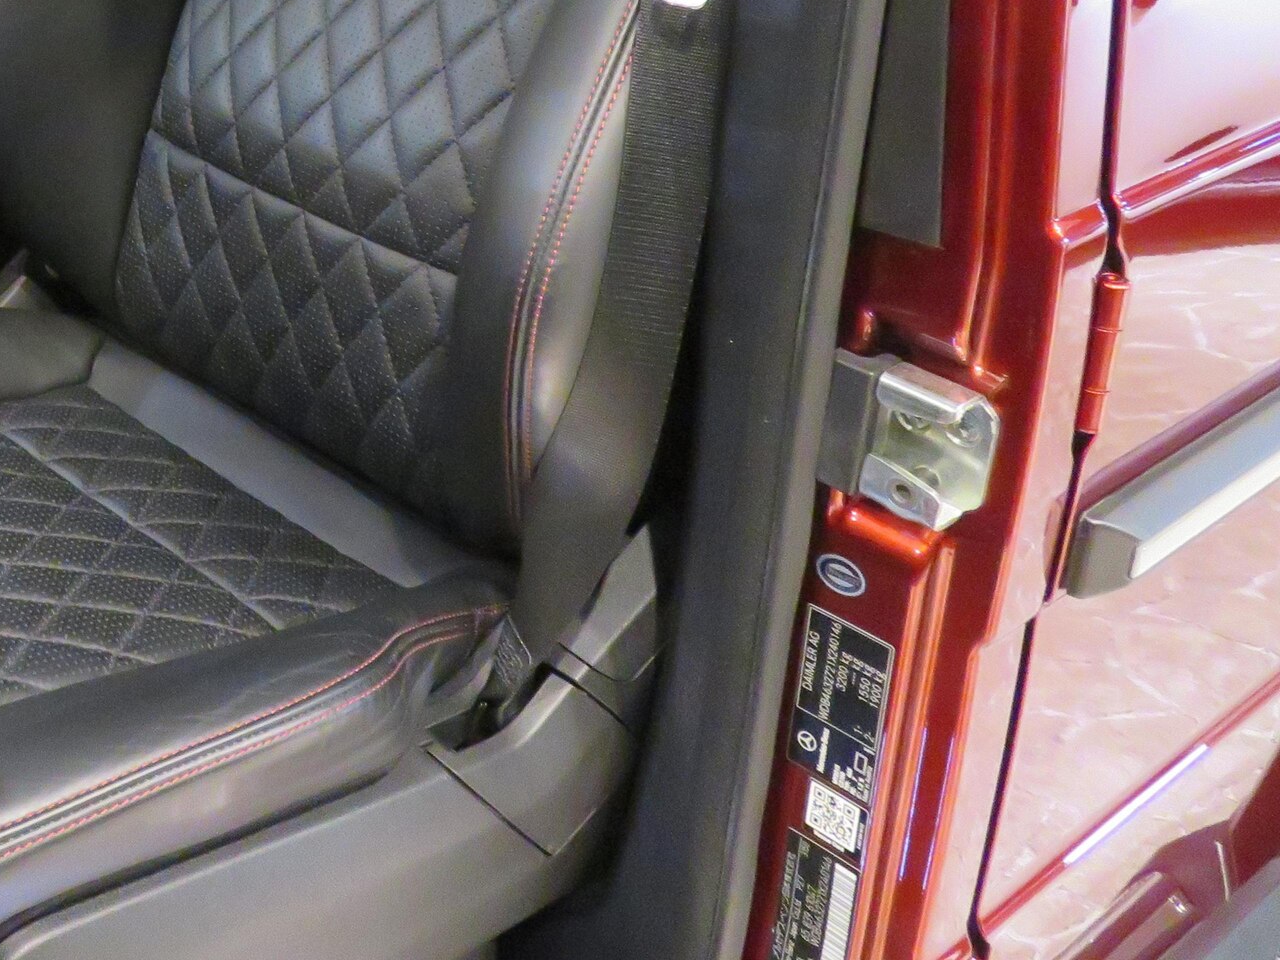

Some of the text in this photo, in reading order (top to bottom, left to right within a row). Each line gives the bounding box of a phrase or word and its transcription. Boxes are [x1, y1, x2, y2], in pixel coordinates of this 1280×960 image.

[802, 629, 820, 691] DAIMLER AG
[835, 650, 852, 692] 3200 kg
[862, 662, 875, 679] kg
[858, 676, 870, 703] 1550
[874, 669, 886, 685] kg
[869, 683, 881, 709] 1900
